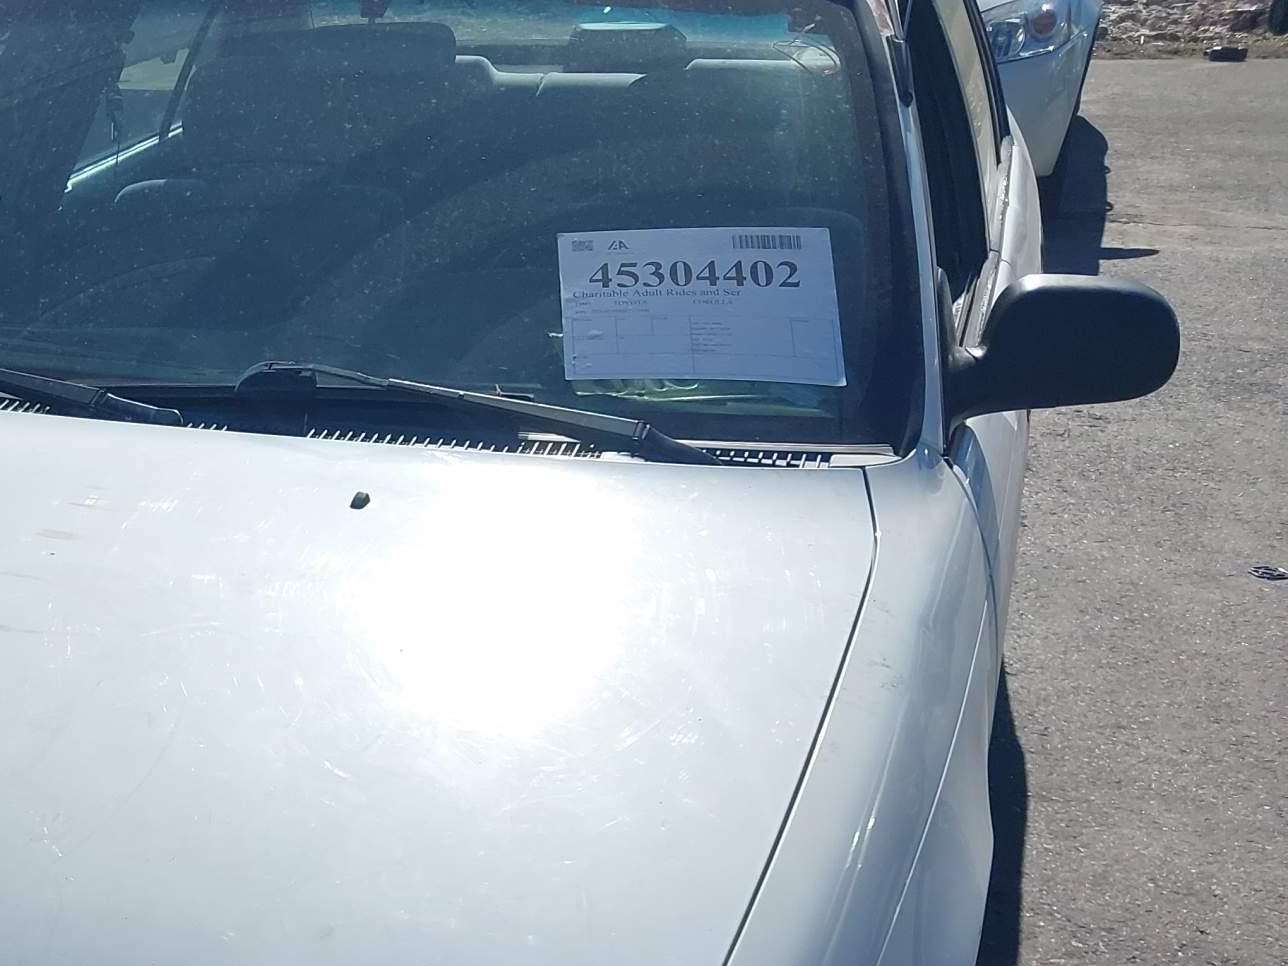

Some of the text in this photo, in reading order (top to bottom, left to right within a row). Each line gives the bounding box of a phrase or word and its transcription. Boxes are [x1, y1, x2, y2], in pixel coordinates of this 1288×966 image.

[589, 260, 801, 288] 45304402
[573, 288, 741, 298] Charitable Adult Rides and Ser
